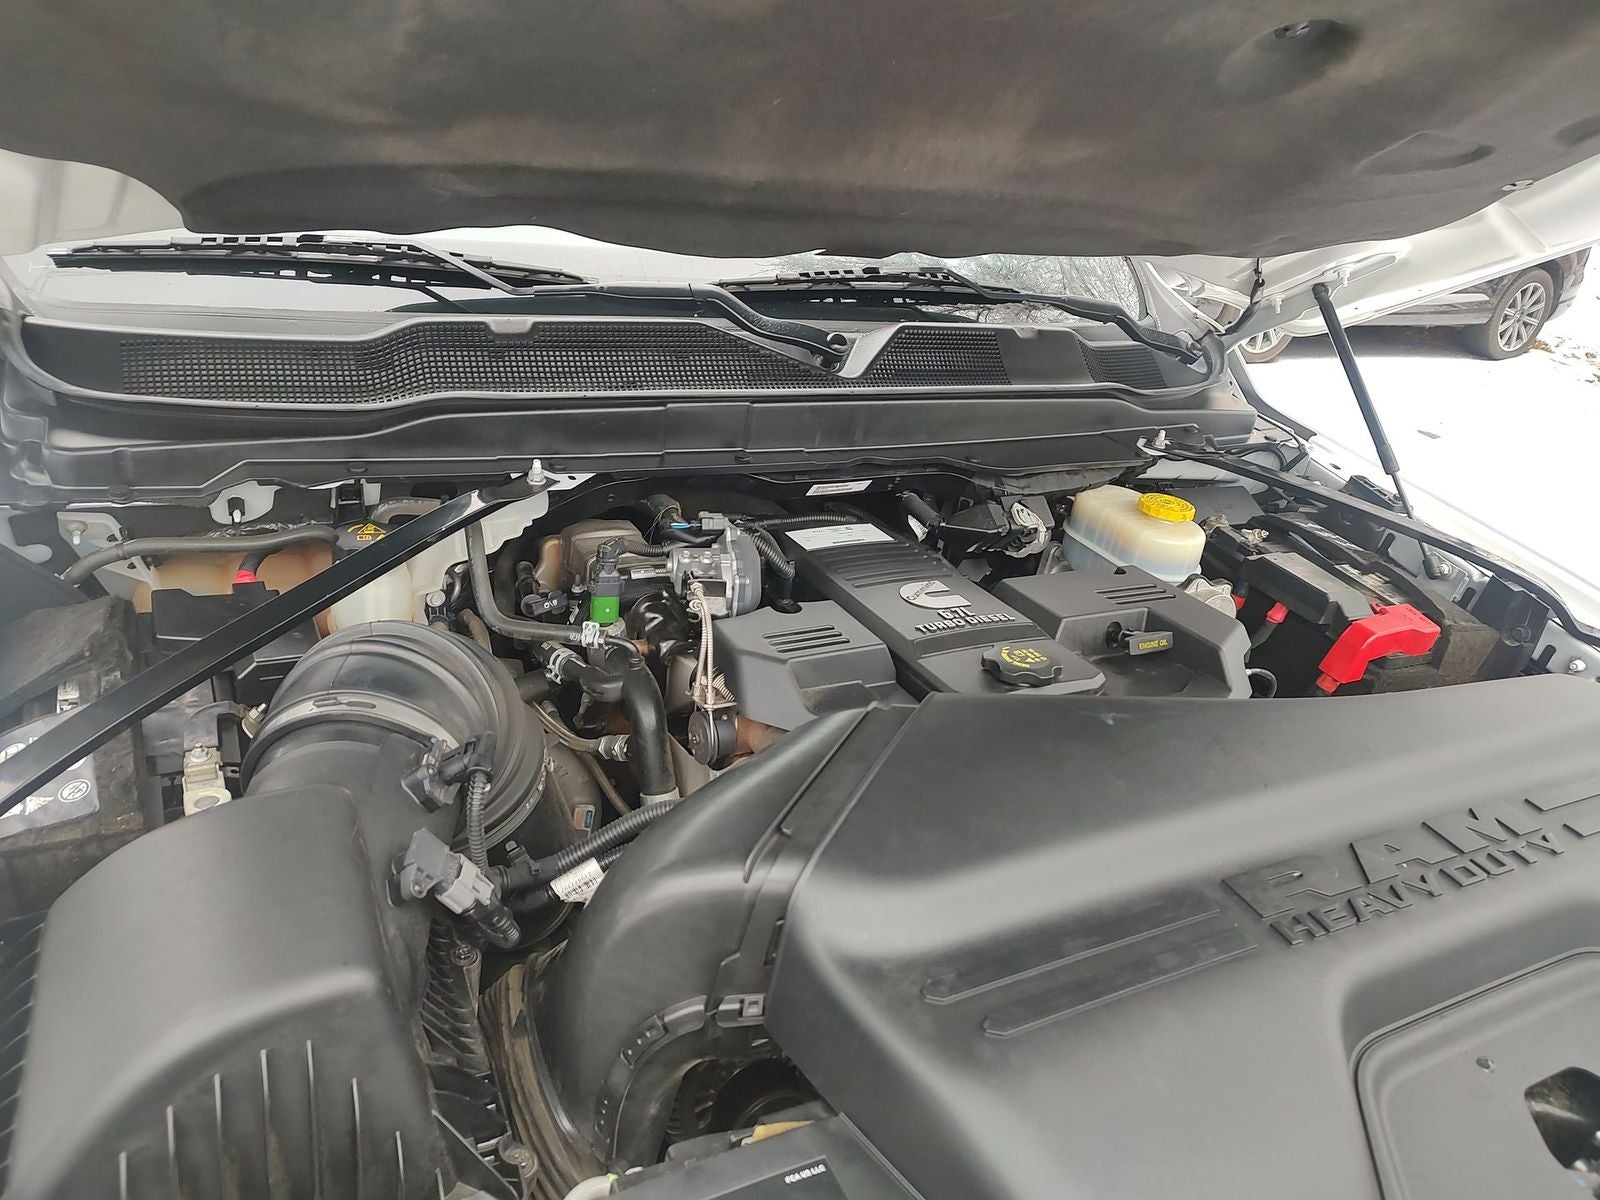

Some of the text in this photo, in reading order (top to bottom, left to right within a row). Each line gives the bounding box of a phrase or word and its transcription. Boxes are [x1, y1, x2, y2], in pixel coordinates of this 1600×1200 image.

[915, 613, 1016, 634] TURBO DIESEL
[937, 606, 976, 620] 6.7L
[1138, 640, 1159, 650] ENGINE
[1222, 801, 1544, 919] RAM
[1269, 833, 1565, 946] HEAVY DUTY
